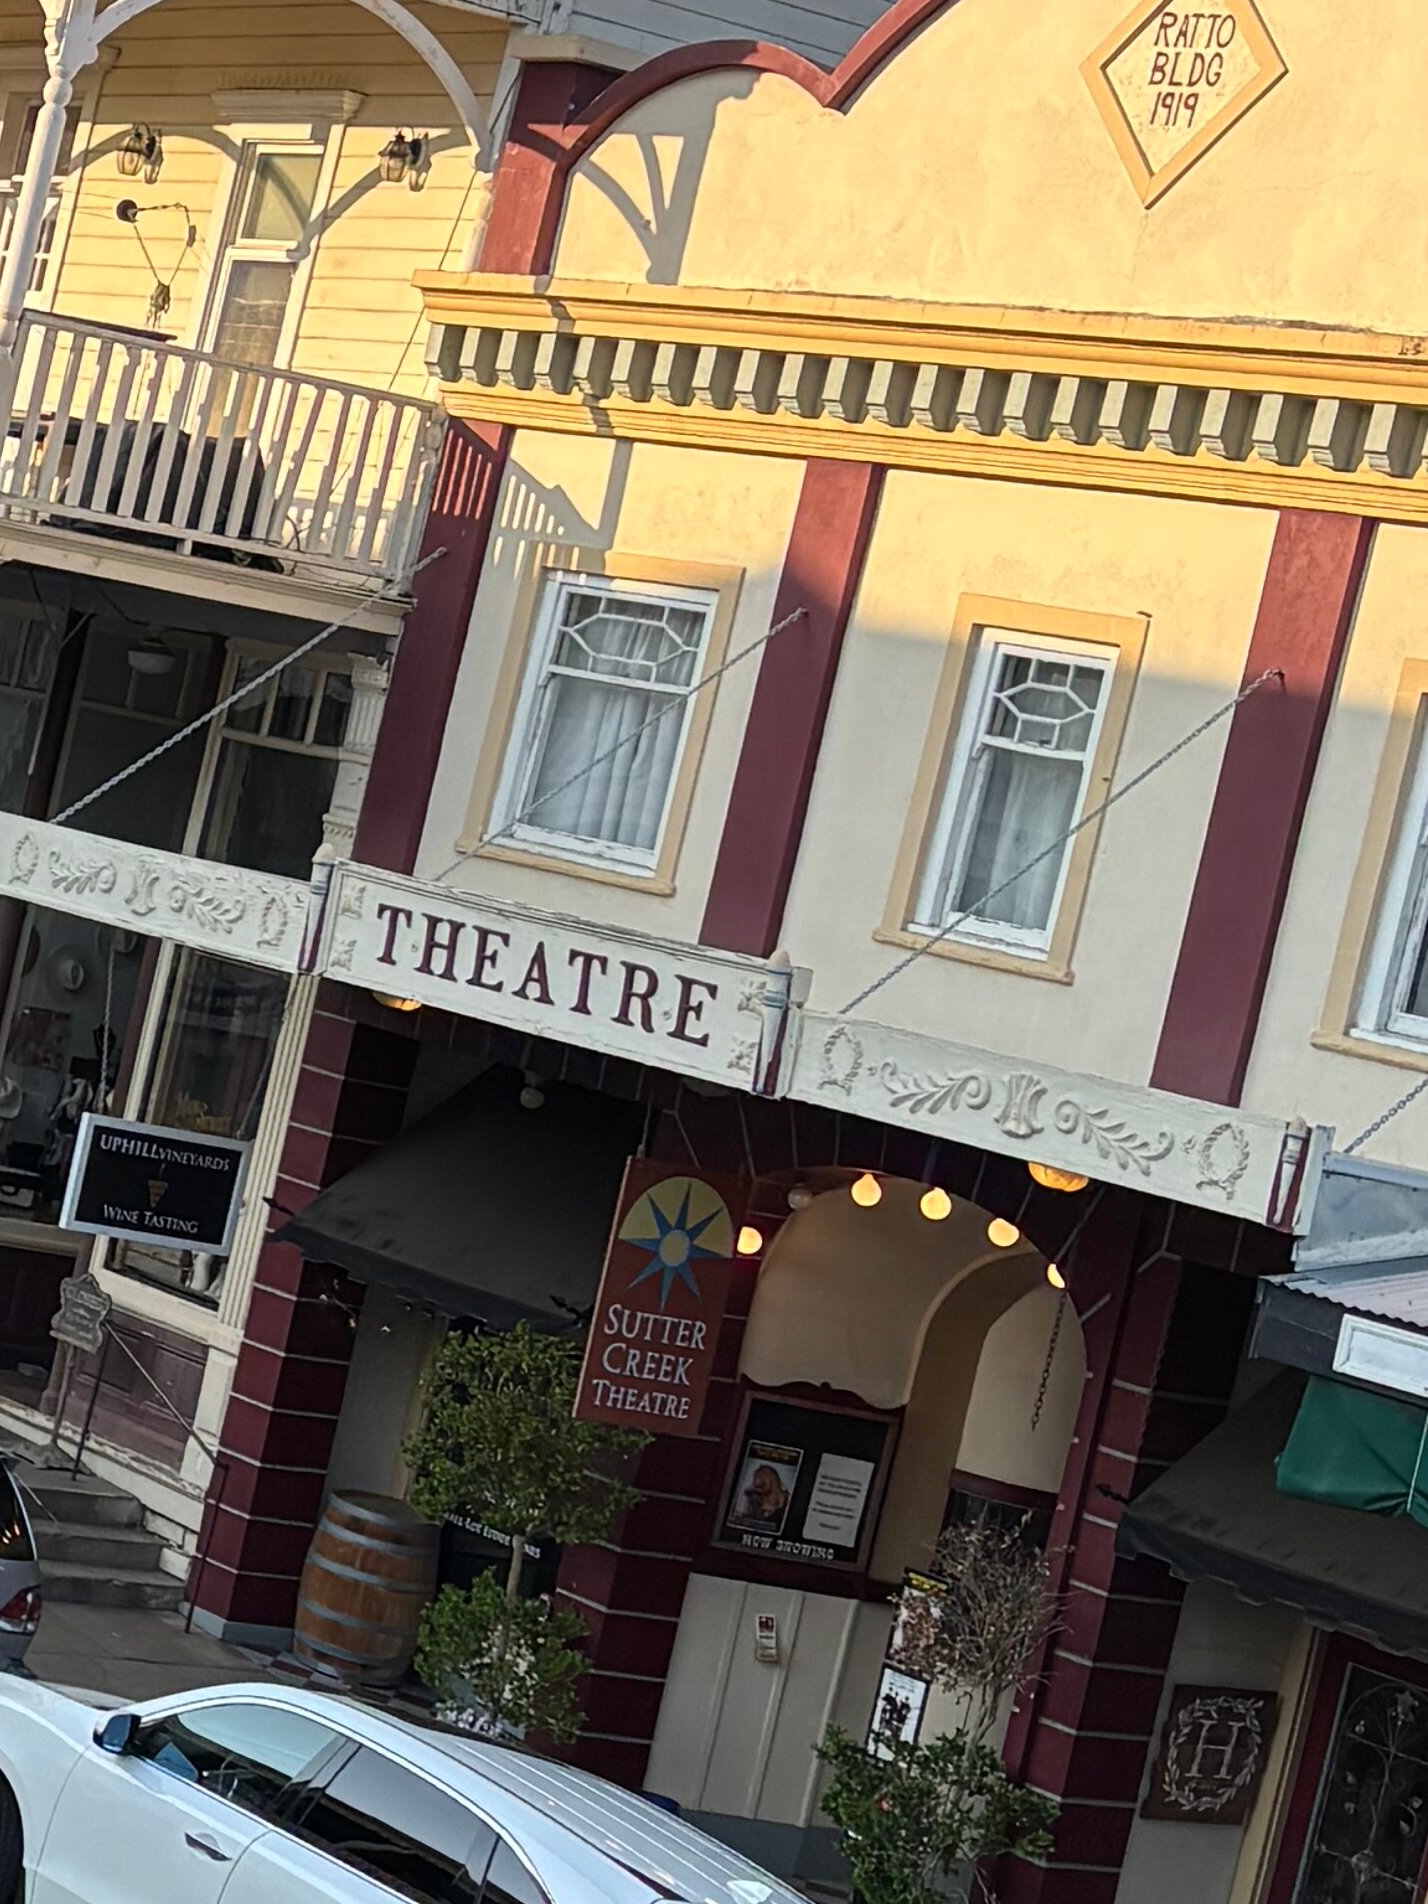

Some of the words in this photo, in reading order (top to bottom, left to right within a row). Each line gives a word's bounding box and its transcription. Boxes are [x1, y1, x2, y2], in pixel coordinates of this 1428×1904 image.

[1154, 11, 1236, 49] RATTO
[1147, 51, 1224, 88] BLDG
[1149, 91, 1200, 129] 1919
[376, 902, 719, 1048] THEATRE
[102, 1204, 140, 1224] WINE
[144, 1211, 200, 1234] TASTING
[604, 1302, 707, 1350] SUTTER
[602, 1342, 694, 1386] CREEK
[592, 1379, 692, 1420] THEATRE
[741, 1533, 774, 1551] NOW
[775, 1539, 835, 1561] SHOWING
[1184, 1719, 1246, 1780] H
